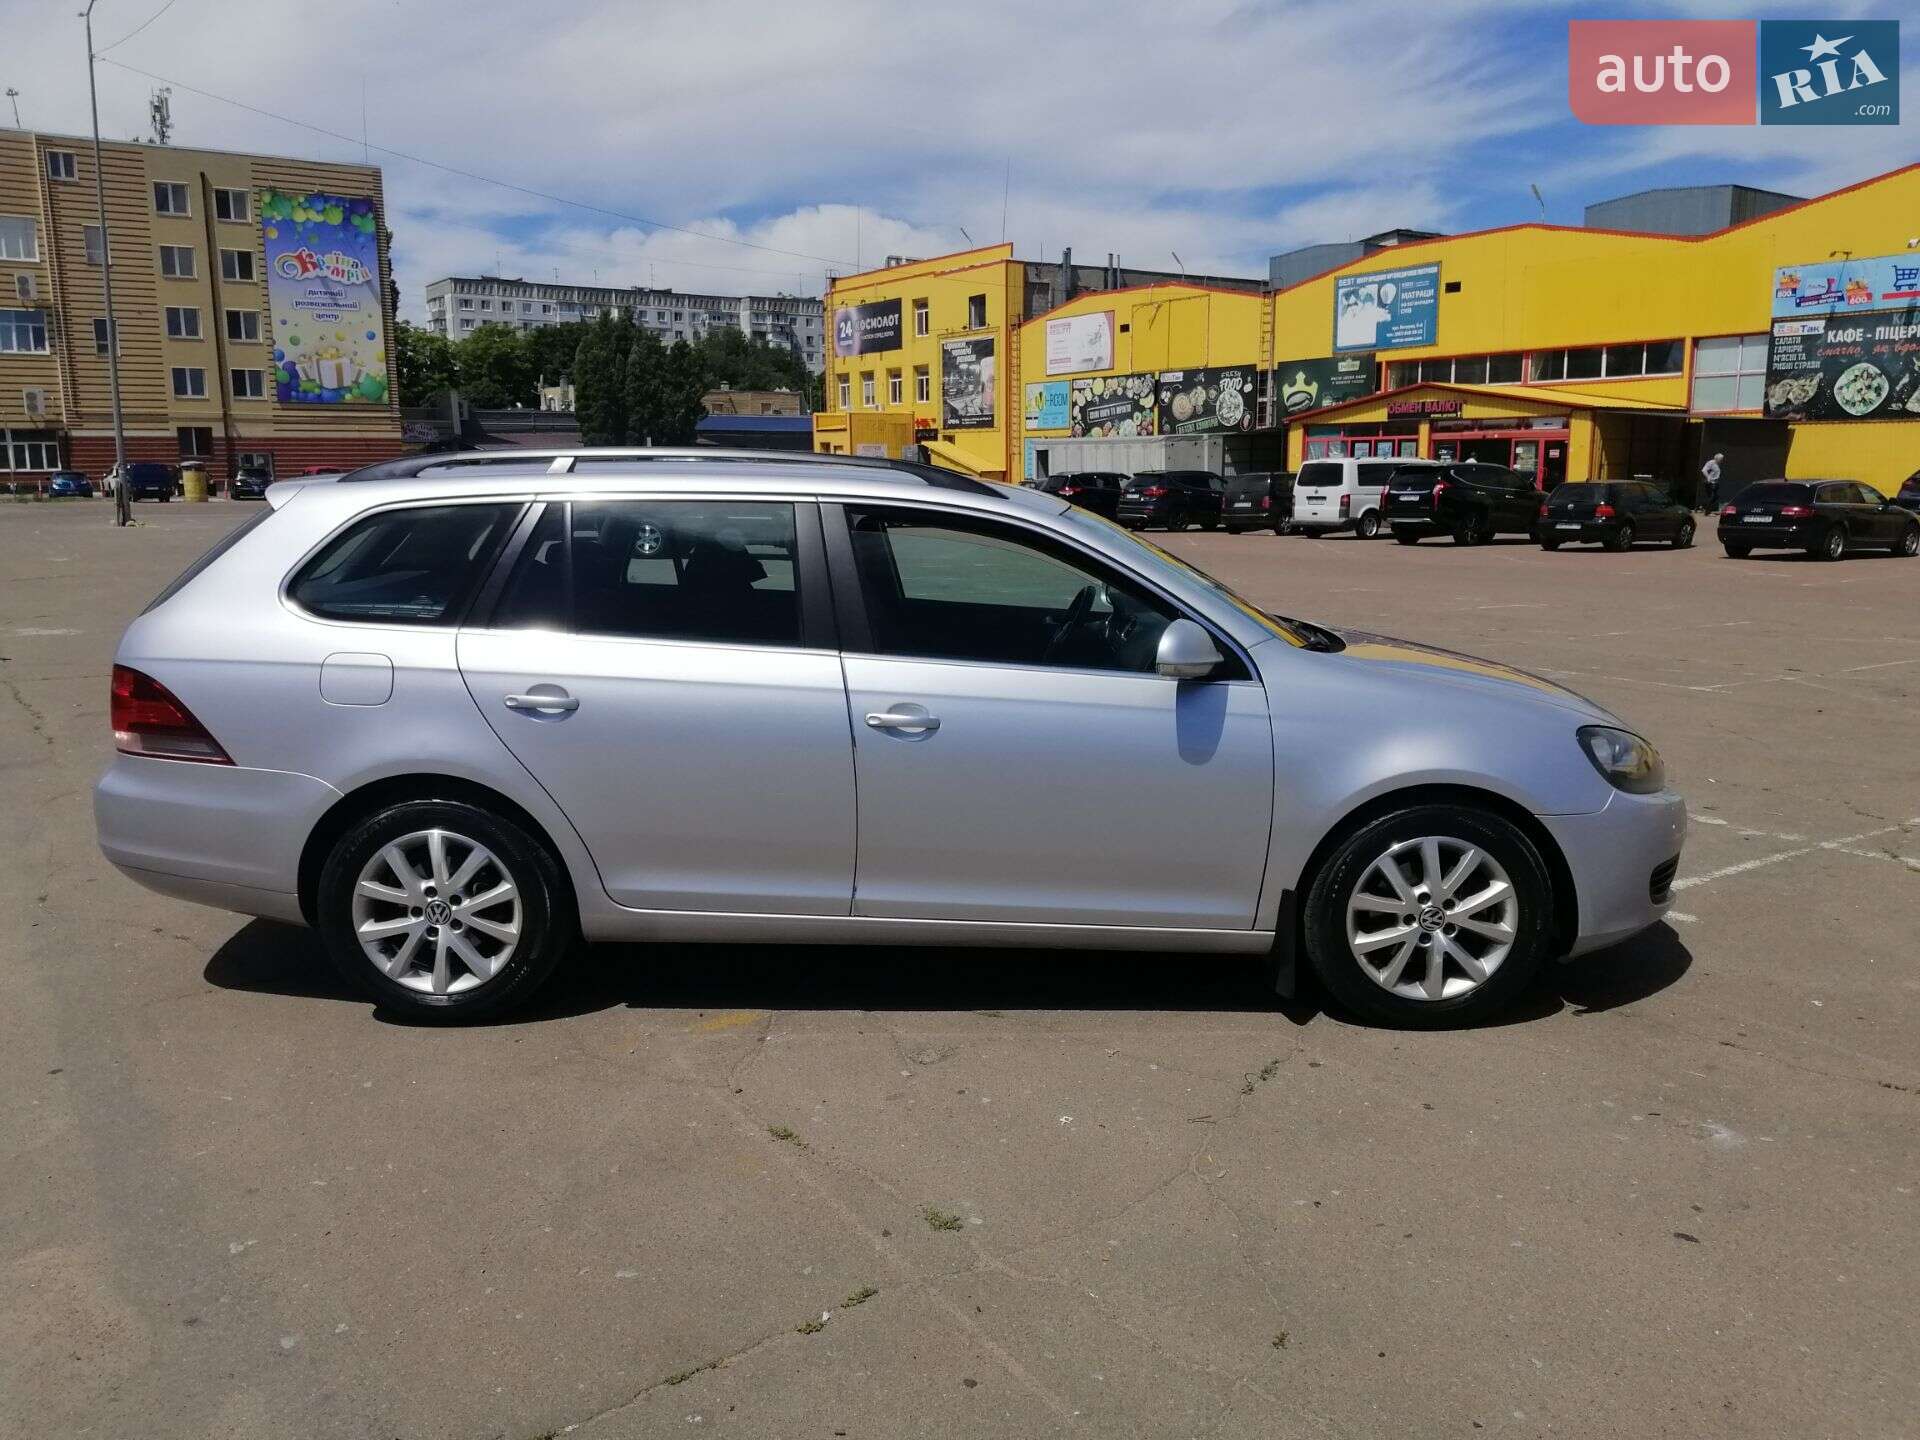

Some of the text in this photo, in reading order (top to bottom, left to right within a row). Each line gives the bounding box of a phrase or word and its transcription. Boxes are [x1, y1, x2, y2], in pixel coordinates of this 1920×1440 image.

[840, 321, 853, 338] 24
[1827, 328, 1864, 344] КАФЕ
[1775, 337, 1801, 345] САЛАТИ
[1220, 378, 1243, 391] FOOD
[1388, 401, 1461, 414] ОБМЕН ВАЛЮТ
